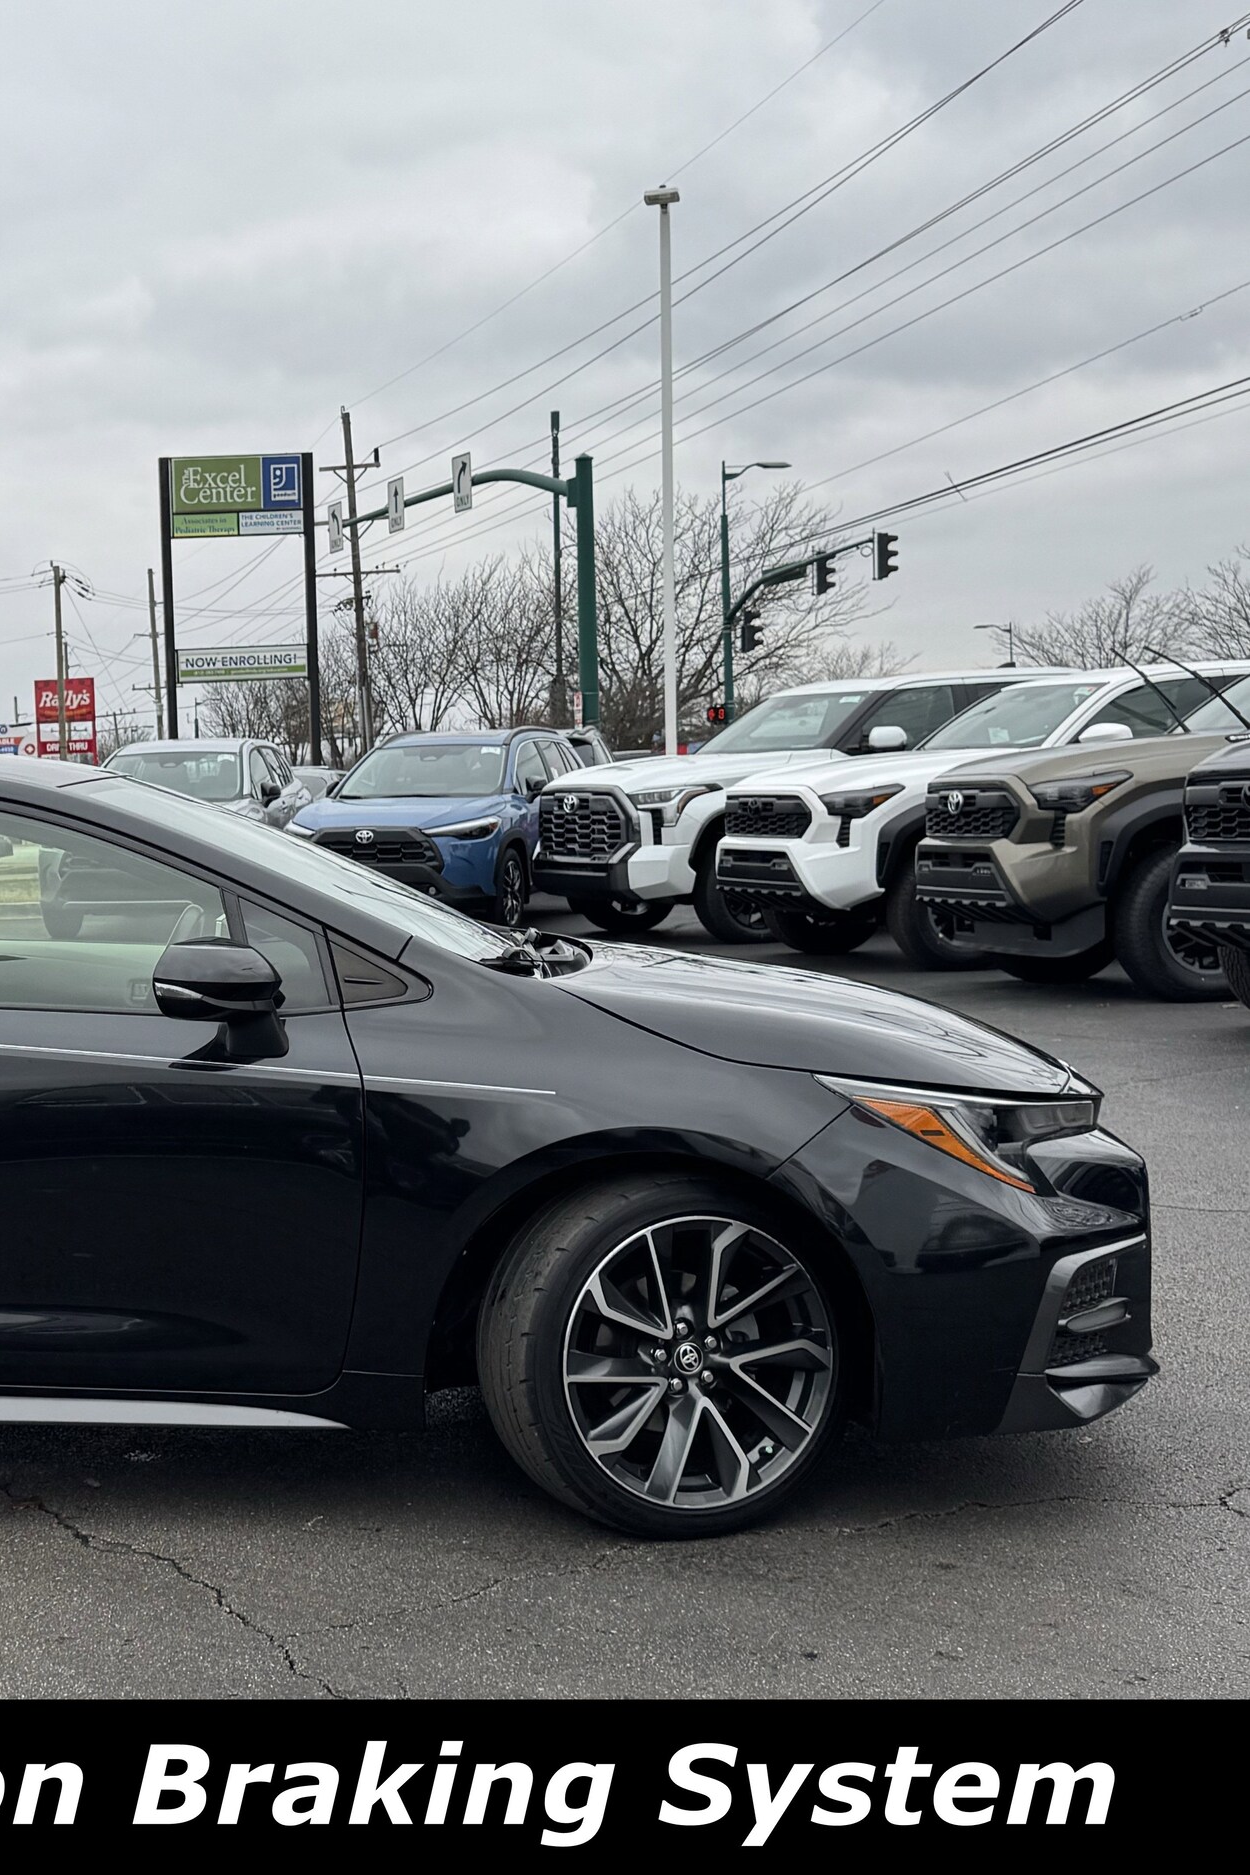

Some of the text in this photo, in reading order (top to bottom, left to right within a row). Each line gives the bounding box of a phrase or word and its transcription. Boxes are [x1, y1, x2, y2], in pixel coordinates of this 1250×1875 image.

[187, 464, 246, 488] Excel
[180, 483, 256, 504] Center
[208, 525, 235, 535] Therapy
[185, 654, 297, 668] NOW ENROLLING!
[39, 689, 90, 709] Rally's
[69, 742, 88, 751] THRU
